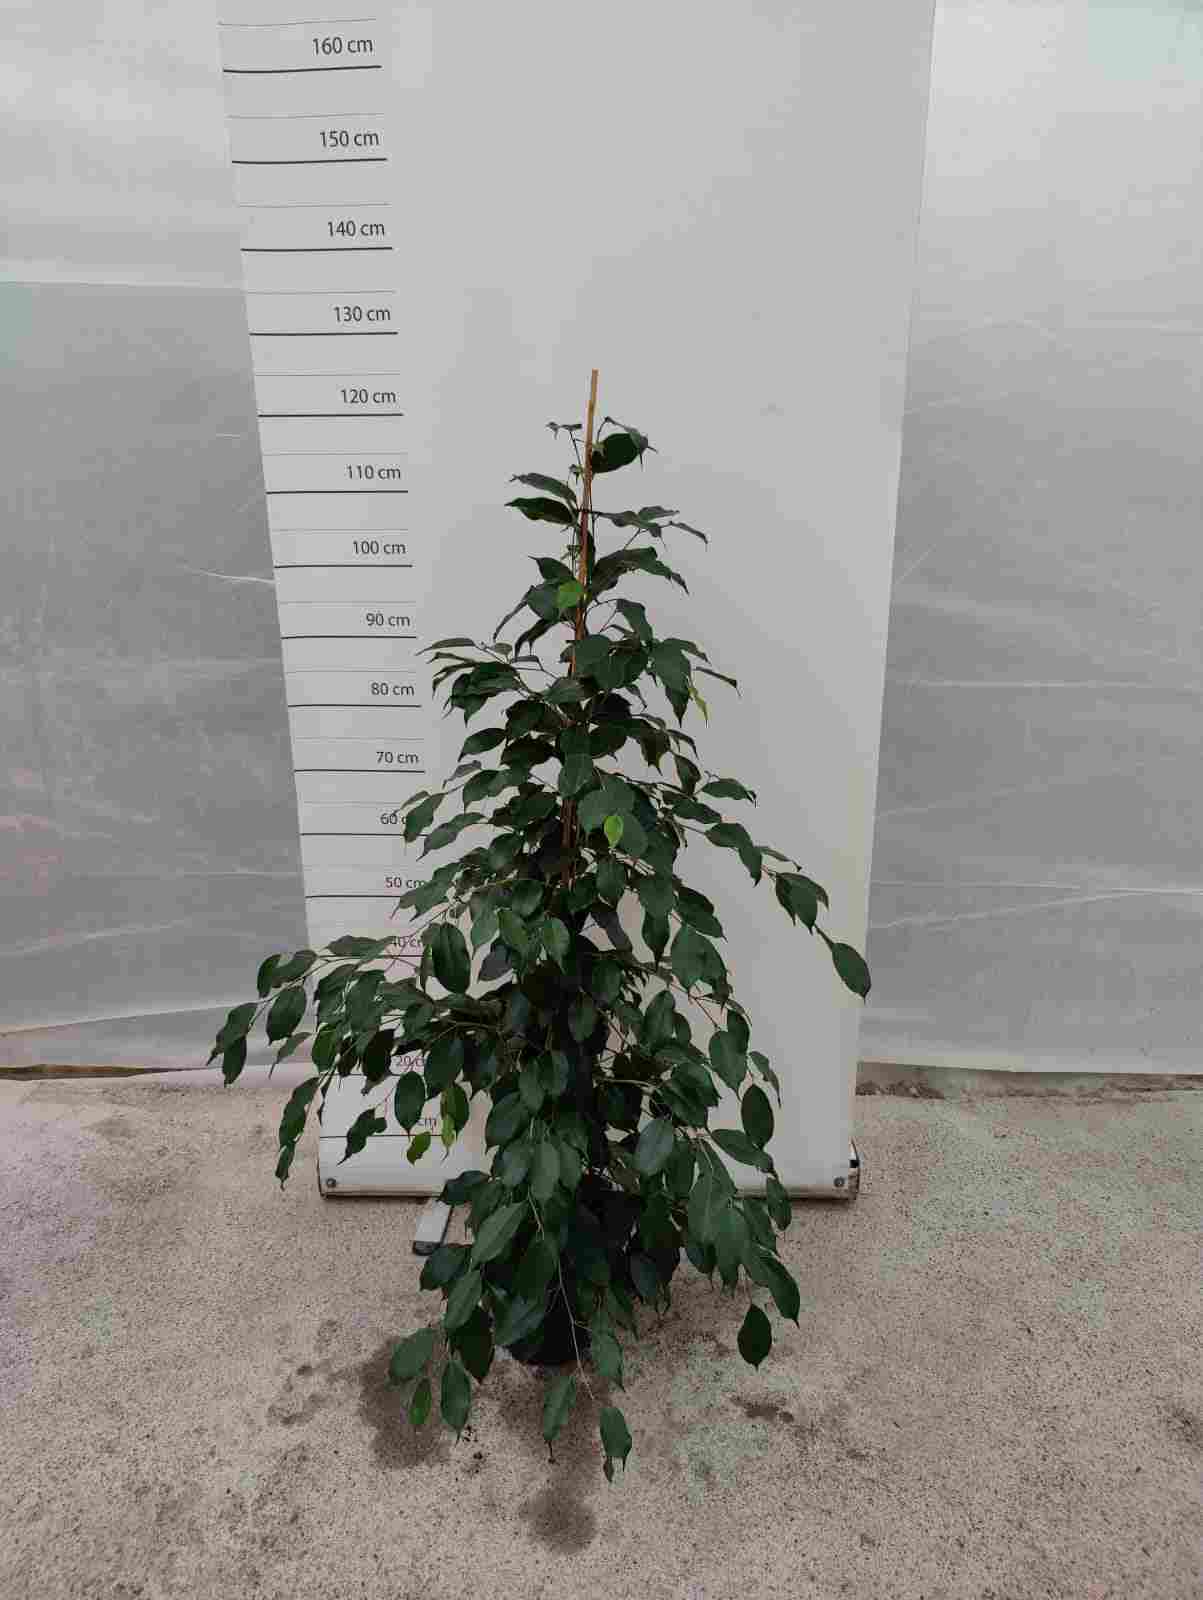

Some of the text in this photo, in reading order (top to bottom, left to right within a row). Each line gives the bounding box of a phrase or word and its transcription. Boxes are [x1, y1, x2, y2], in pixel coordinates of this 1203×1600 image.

[312, 36, 374, 56] 160 cm
[319, 130, 380, 148] 150 cm
[327, 220, 386, 238] 140 cm
[333, 306, 391, 323] 130 cm
[340, 388, 397, 404] 120 cm
[346, 464, 401, 480] 110 cm
[352, 540, 407, 555] 100 cm
[365, 612, 411, 627] 90 cm
[370, 682, 415, 696] 80 cm
[375, 751, 420, 764] 70 cm
[380, 812, 398, 825] 60
[385, 876, 402, 888] 50
